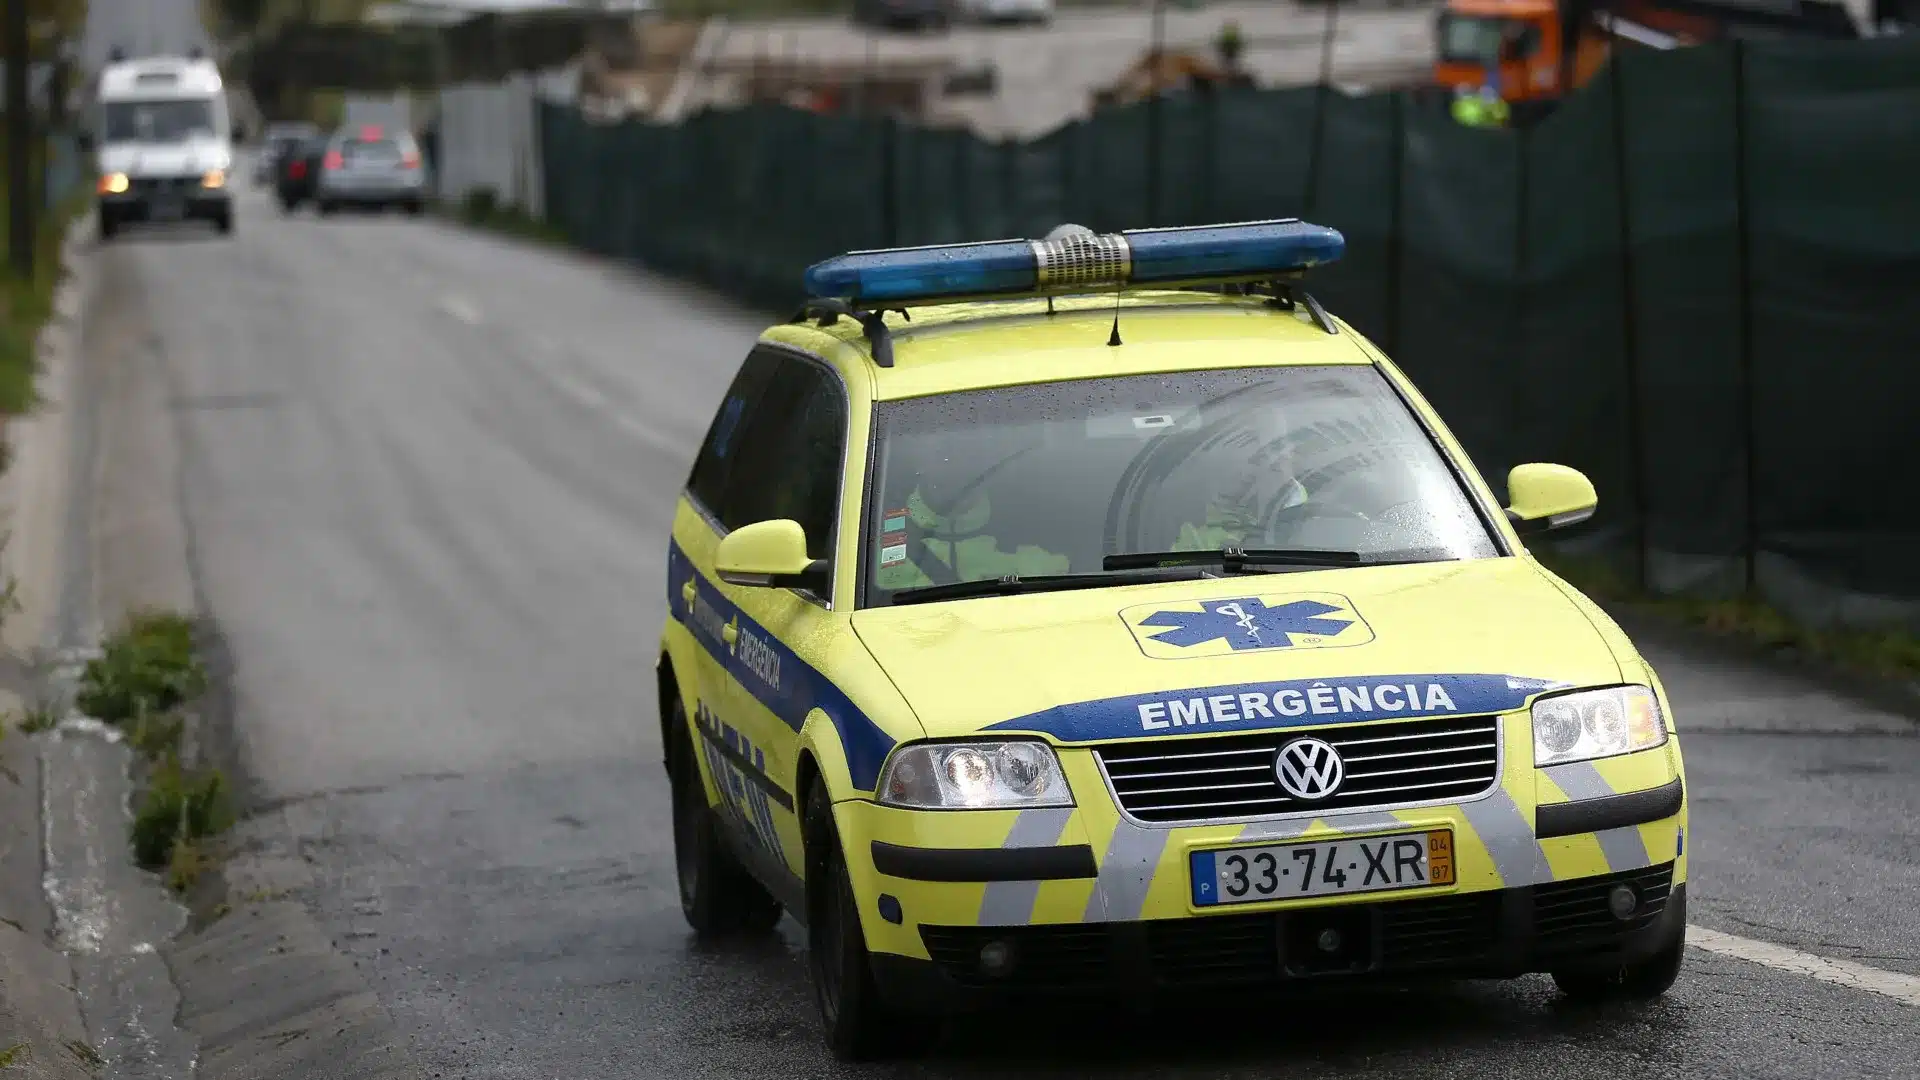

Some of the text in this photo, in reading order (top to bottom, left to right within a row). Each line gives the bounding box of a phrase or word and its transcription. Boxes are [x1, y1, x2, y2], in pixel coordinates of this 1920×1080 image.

[739, 627, 780, 691] EMERGÊNCIA
[1137, 682, 1457, 731] EMERGÊNCIA
[1275, 739, 1343, 800] VW
[1430, 838, 1447, 851] 04
[1200, 882, 1210, 895] P
[1431, 865, 1449, 882] 07
